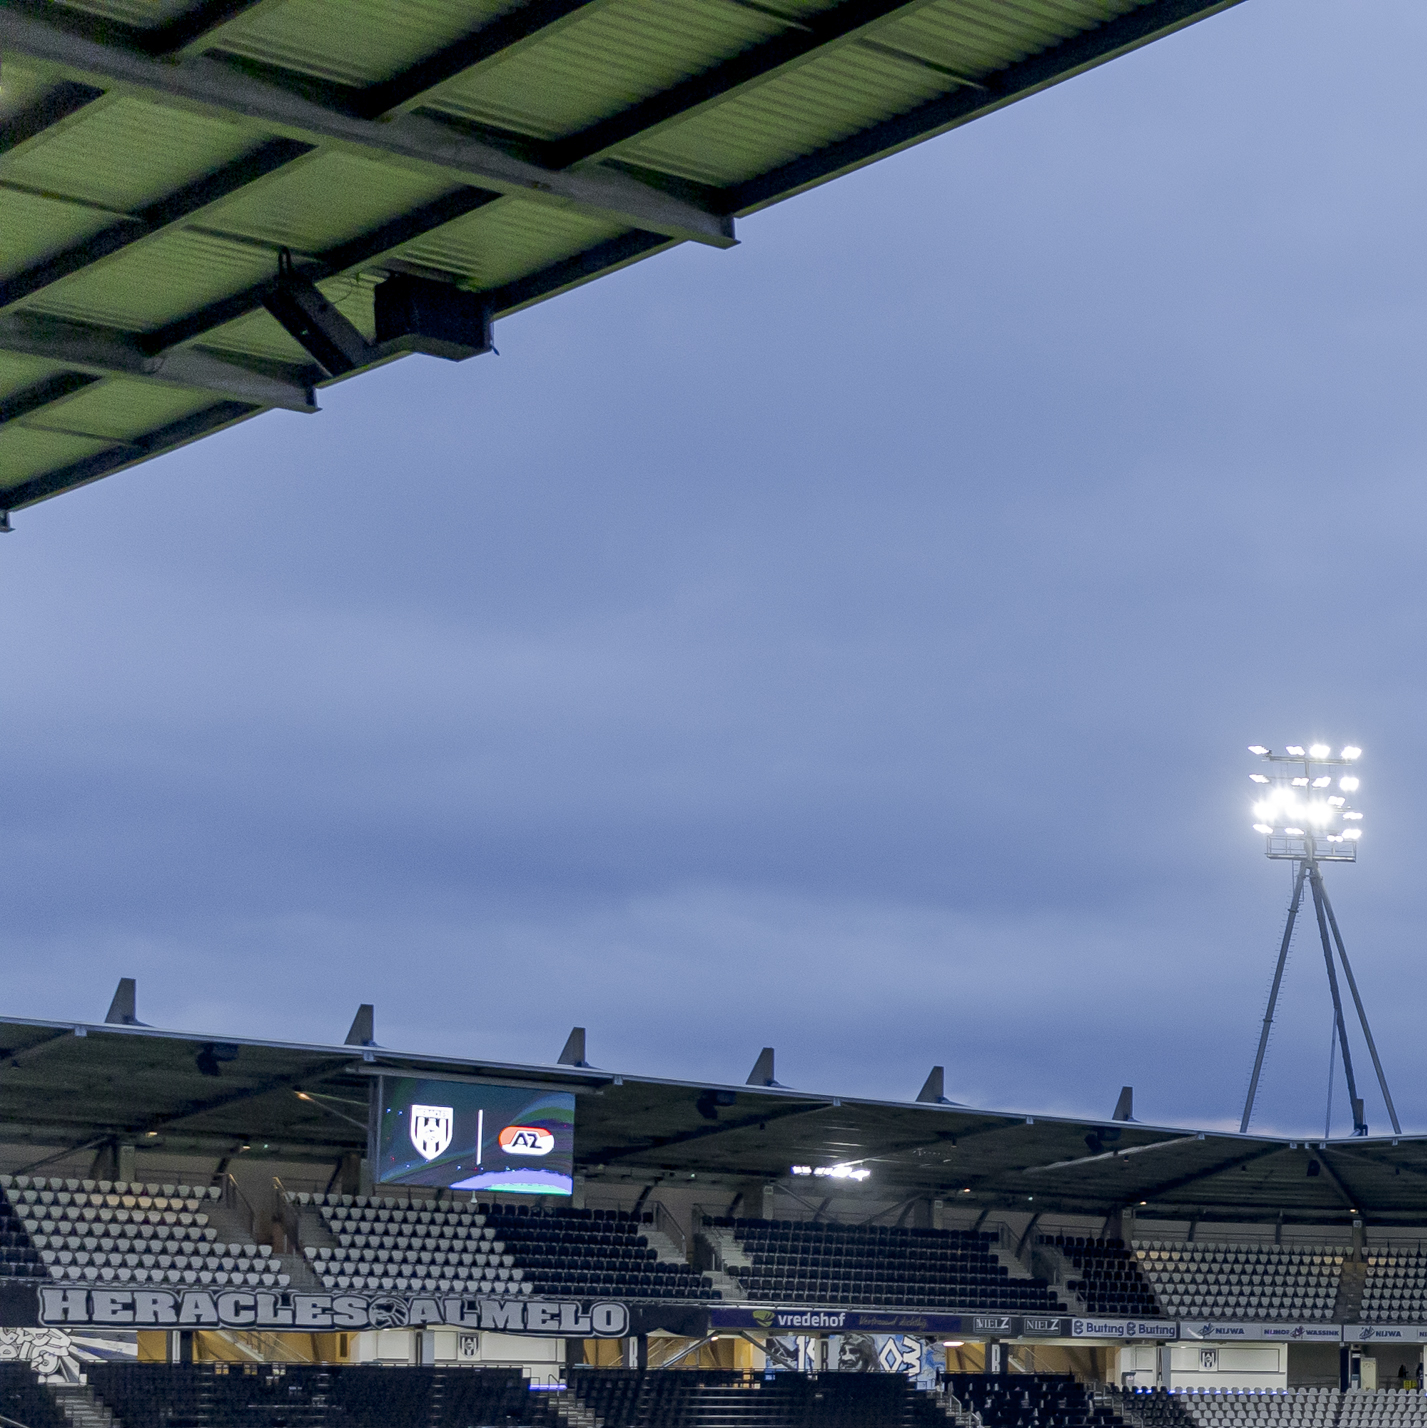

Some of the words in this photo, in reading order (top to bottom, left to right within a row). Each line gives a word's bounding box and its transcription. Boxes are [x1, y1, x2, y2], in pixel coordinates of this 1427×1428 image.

[512, 1132, 543, 1149] AZ
[41, 1287, 369, 1328] HERACLES
[409, 1297, 628, 1337] ALMELO
[777, 1312, 845, 1328] vredehof
[976, 1316, 1010, 1330] NIELZ
[1026, 1318, 1060, 1331] NIELZ
[1086, 1320, 1125, 1335] Buiting
[1138, 1322, 1176, 1338] Buiting
[1215, 1327, 1245, 1335] NIJWA
[1375, 1330, 1402, 1338] NIJWA
